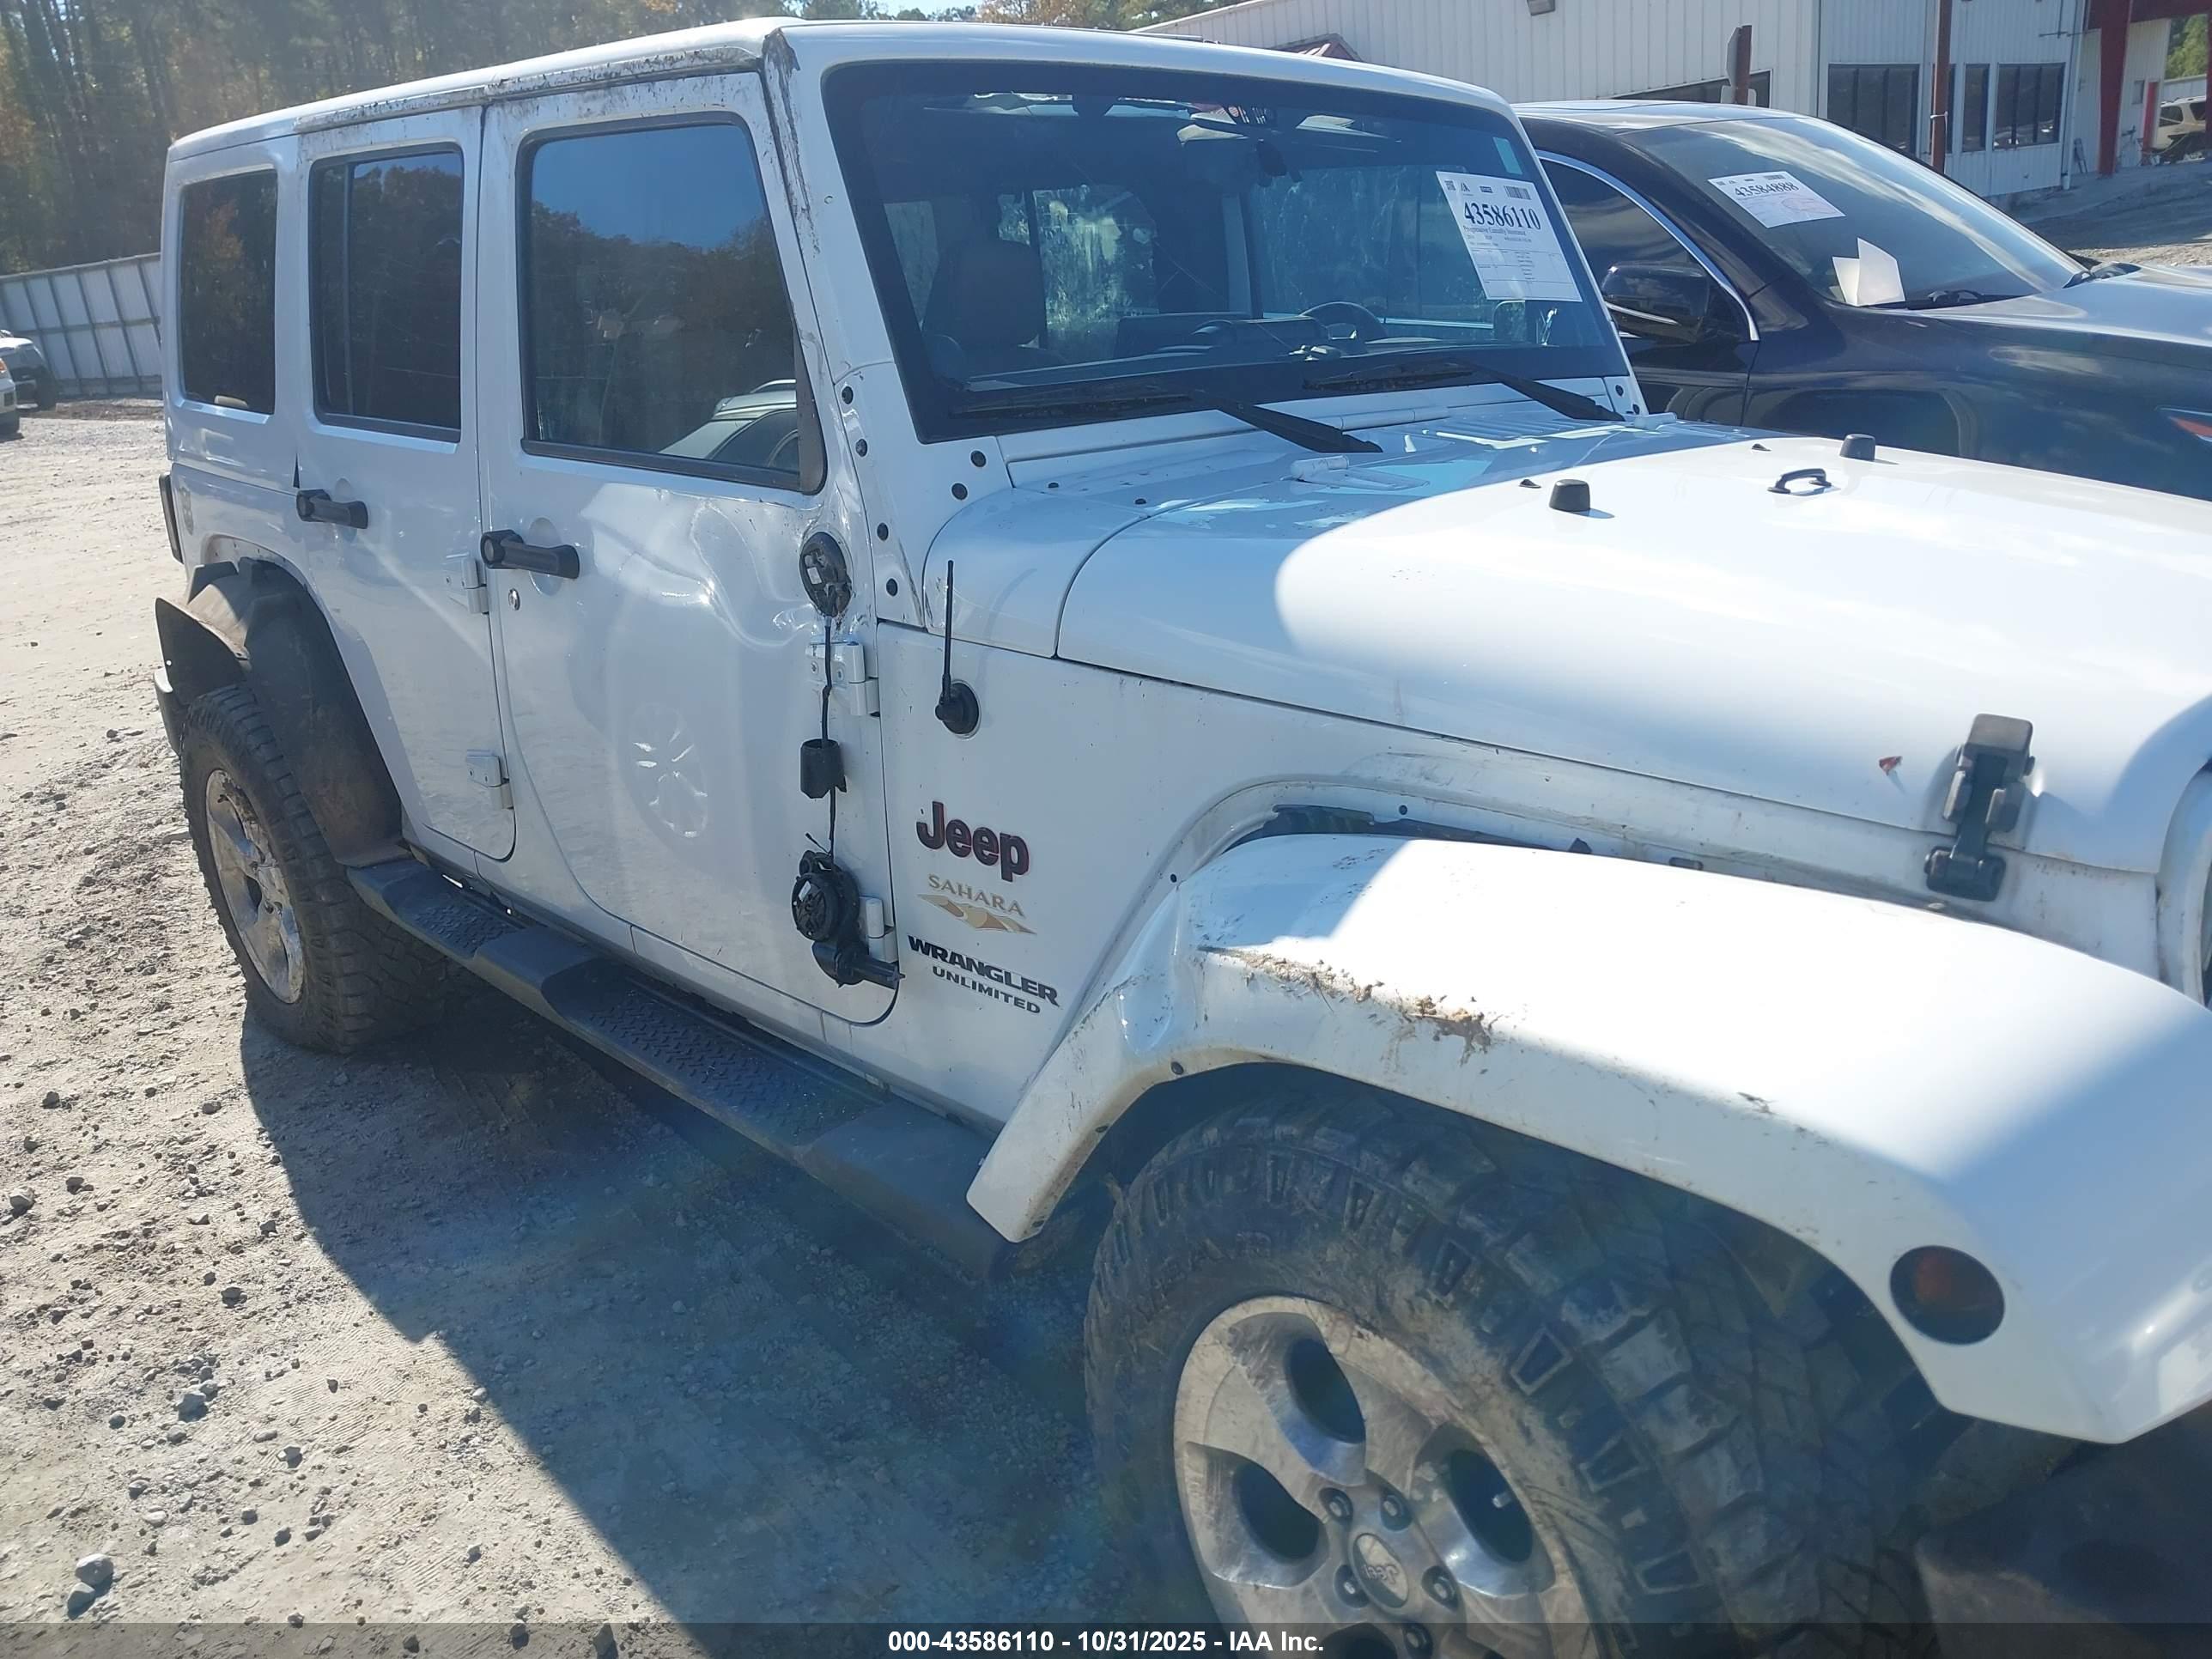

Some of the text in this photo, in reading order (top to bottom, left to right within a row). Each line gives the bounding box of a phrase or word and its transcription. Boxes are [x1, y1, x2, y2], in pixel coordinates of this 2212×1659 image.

[1735, 181, 1800, 197] 43584888
[1464, 202, 1541, 230] 43586110
[915, 799, 1030, 883] Jeep
[927, 873, 1026, 919] SAHARA
[908, 934, 1061, 1008] WRANGLER
[933, 966, 1041, 1014] UNLIMITED
